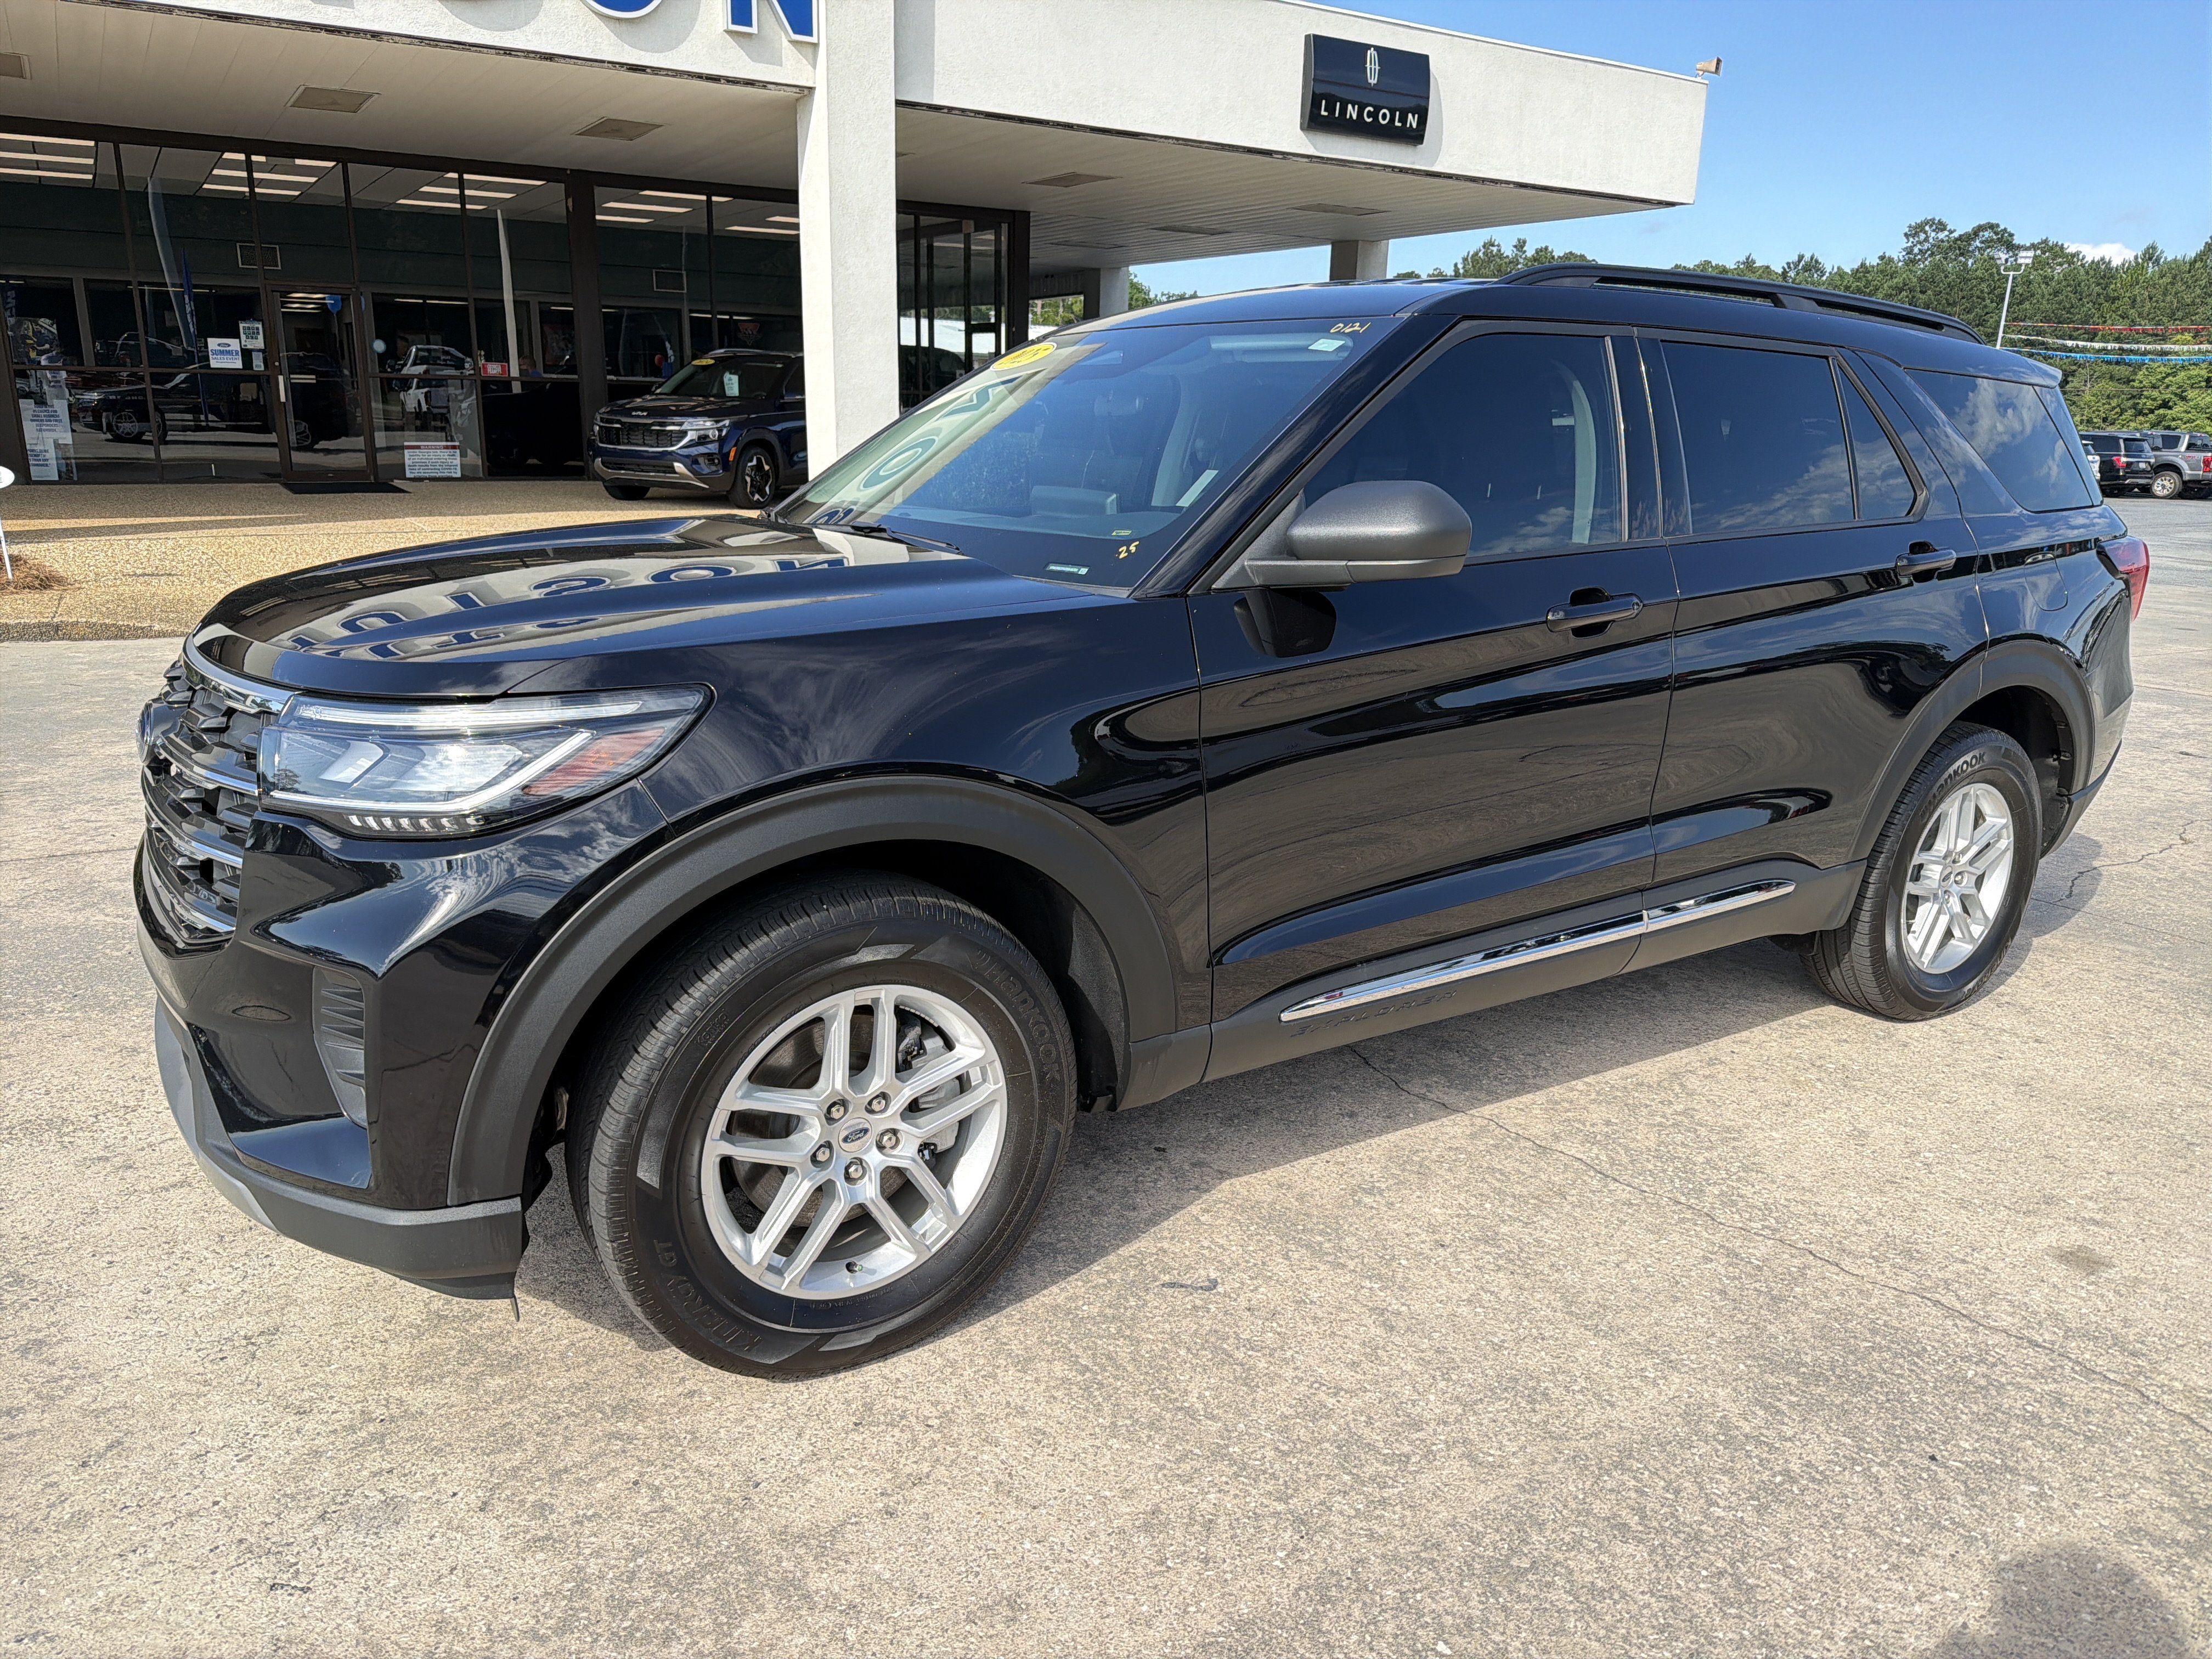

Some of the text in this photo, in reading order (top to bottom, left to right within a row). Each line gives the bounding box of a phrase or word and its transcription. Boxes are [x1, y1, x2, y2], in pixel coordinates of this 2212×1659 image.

[1320, 99, 1418, 129] LINCOLN
[1330, 322, 1371, 333] 0121
[1290, 990, 1457, 1037] EXPLORER
[848, 1130, 865, 1142] Ford
